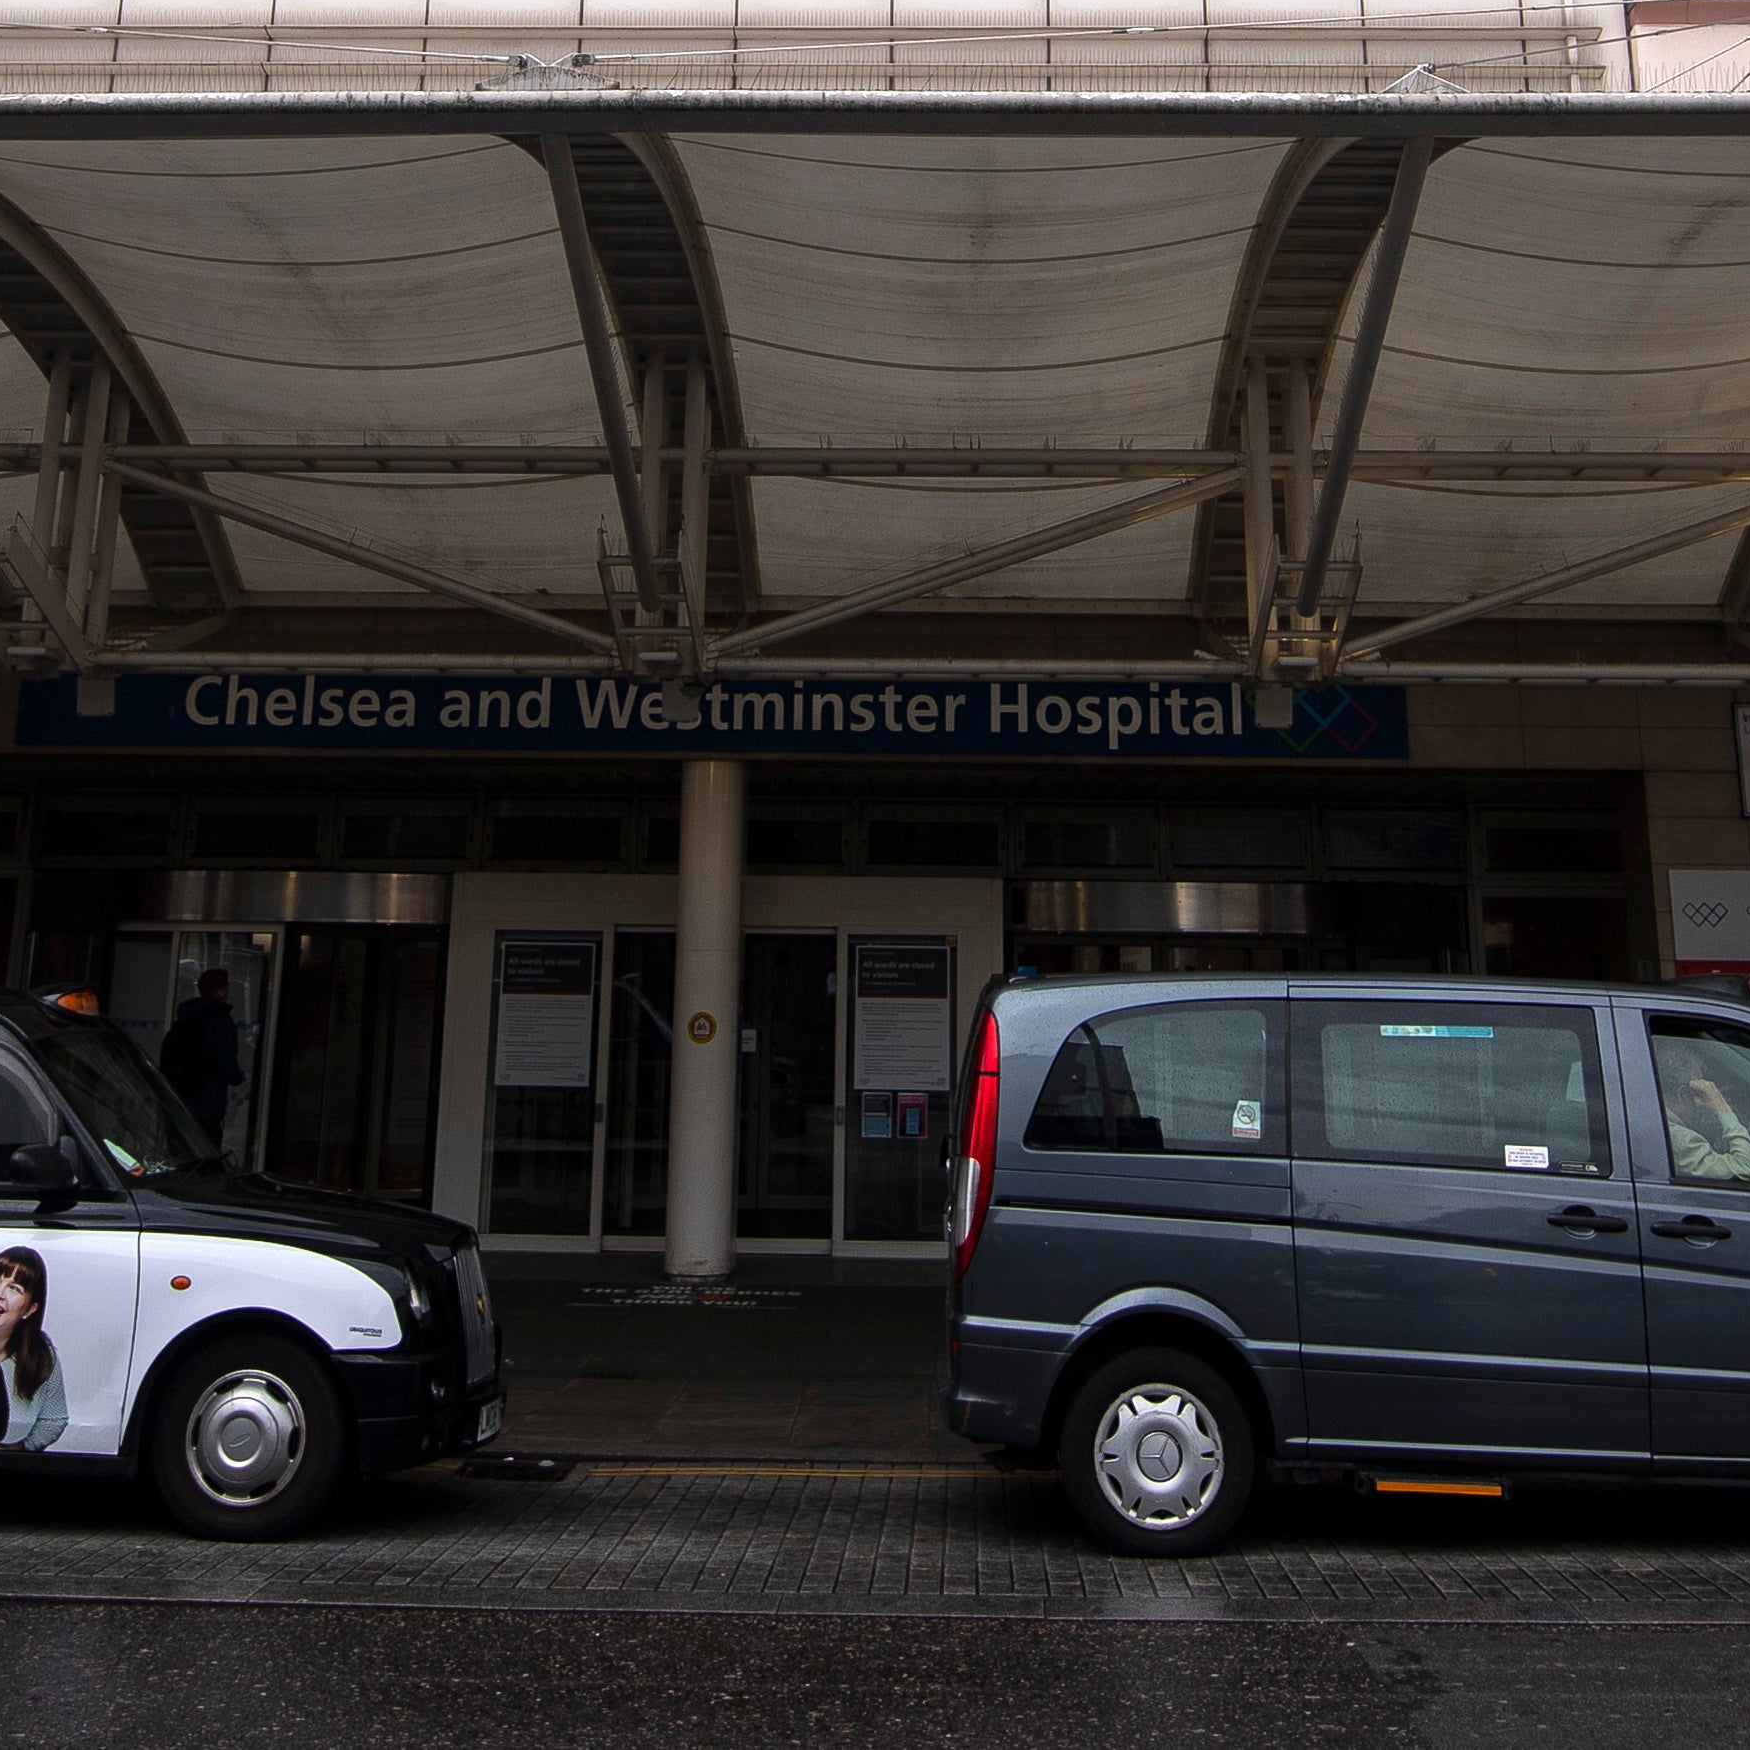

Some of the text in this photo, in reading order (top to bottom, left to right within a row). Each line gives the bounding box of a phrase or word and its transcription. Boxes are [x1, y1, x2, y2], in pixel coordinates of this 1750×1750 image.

[184, 674, 1243, 750] Chelsea and Wetminster Hospital
[349, 1326, 383, 1335] UBIQUITOUS
